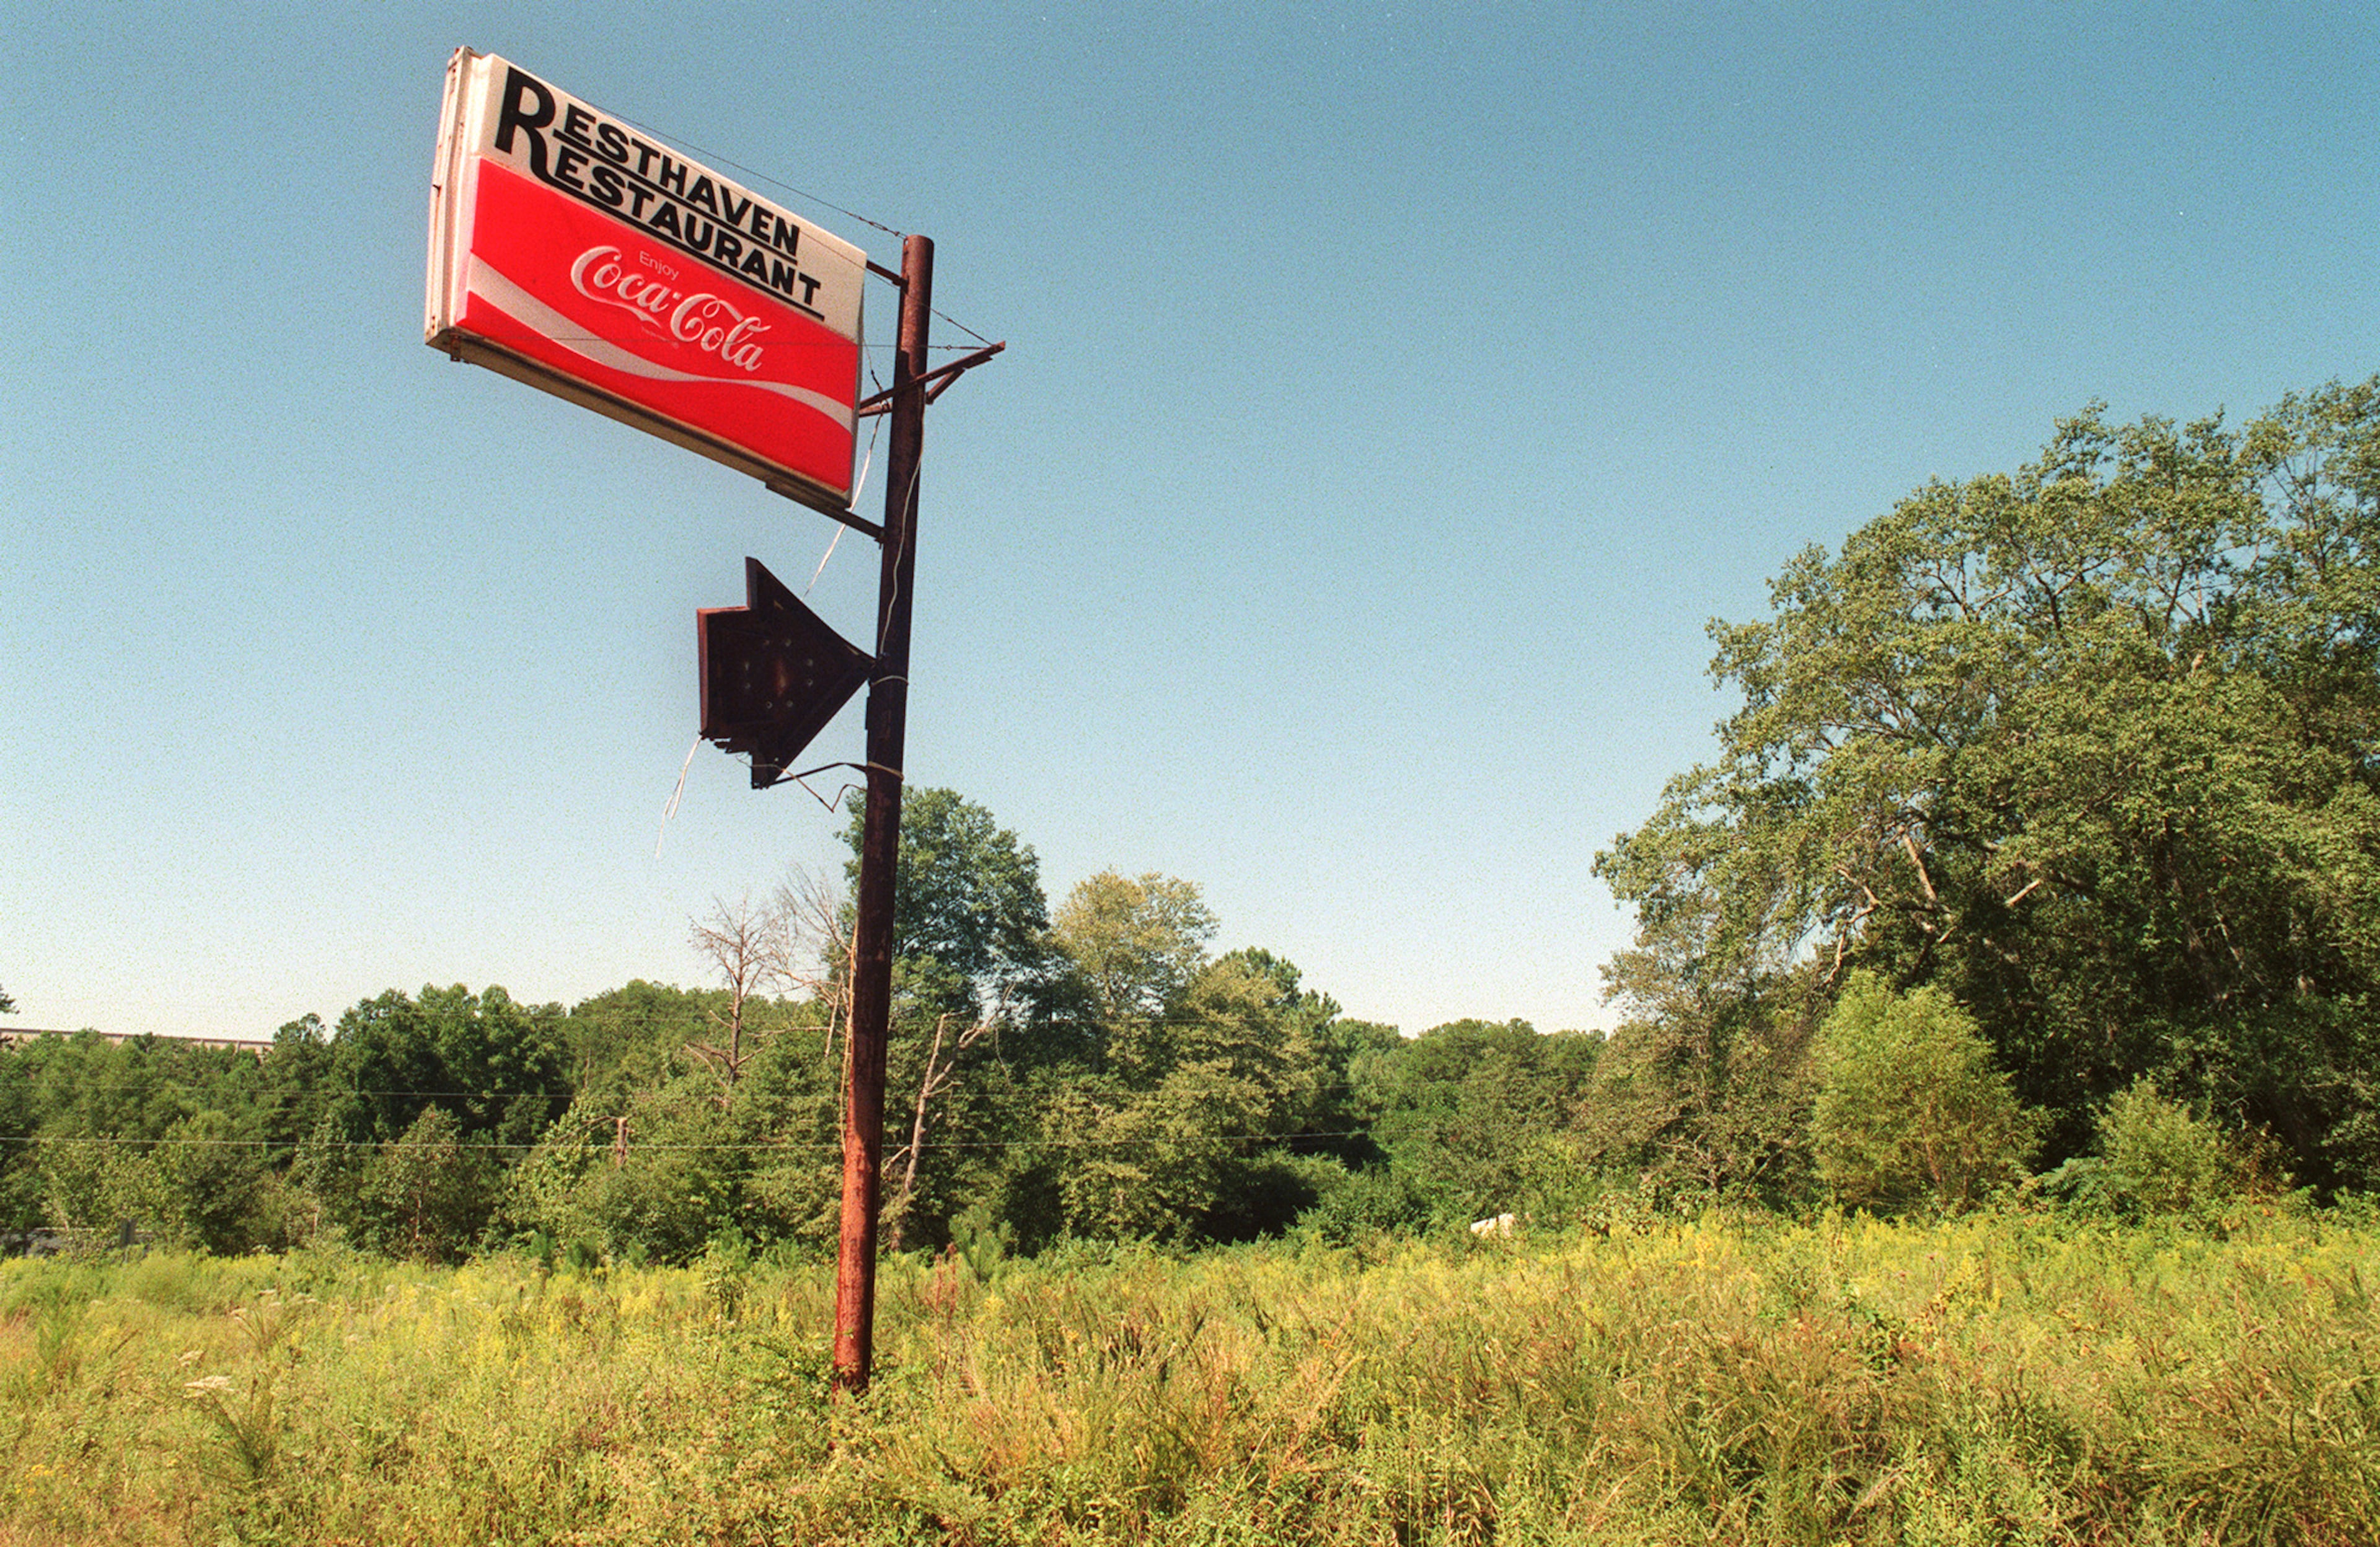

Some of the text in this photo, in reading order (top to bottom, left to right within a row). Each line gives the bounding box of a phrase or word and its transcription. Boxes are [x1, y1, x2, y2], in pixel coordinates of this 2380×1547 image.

[495, 66, 800, 257] RESTHAVEN
[495, 66, 821, 307] RESTAURANT
[571, 246, 771, 371] Coca-Cola
[639, 250, 679, 281] Enjoy
